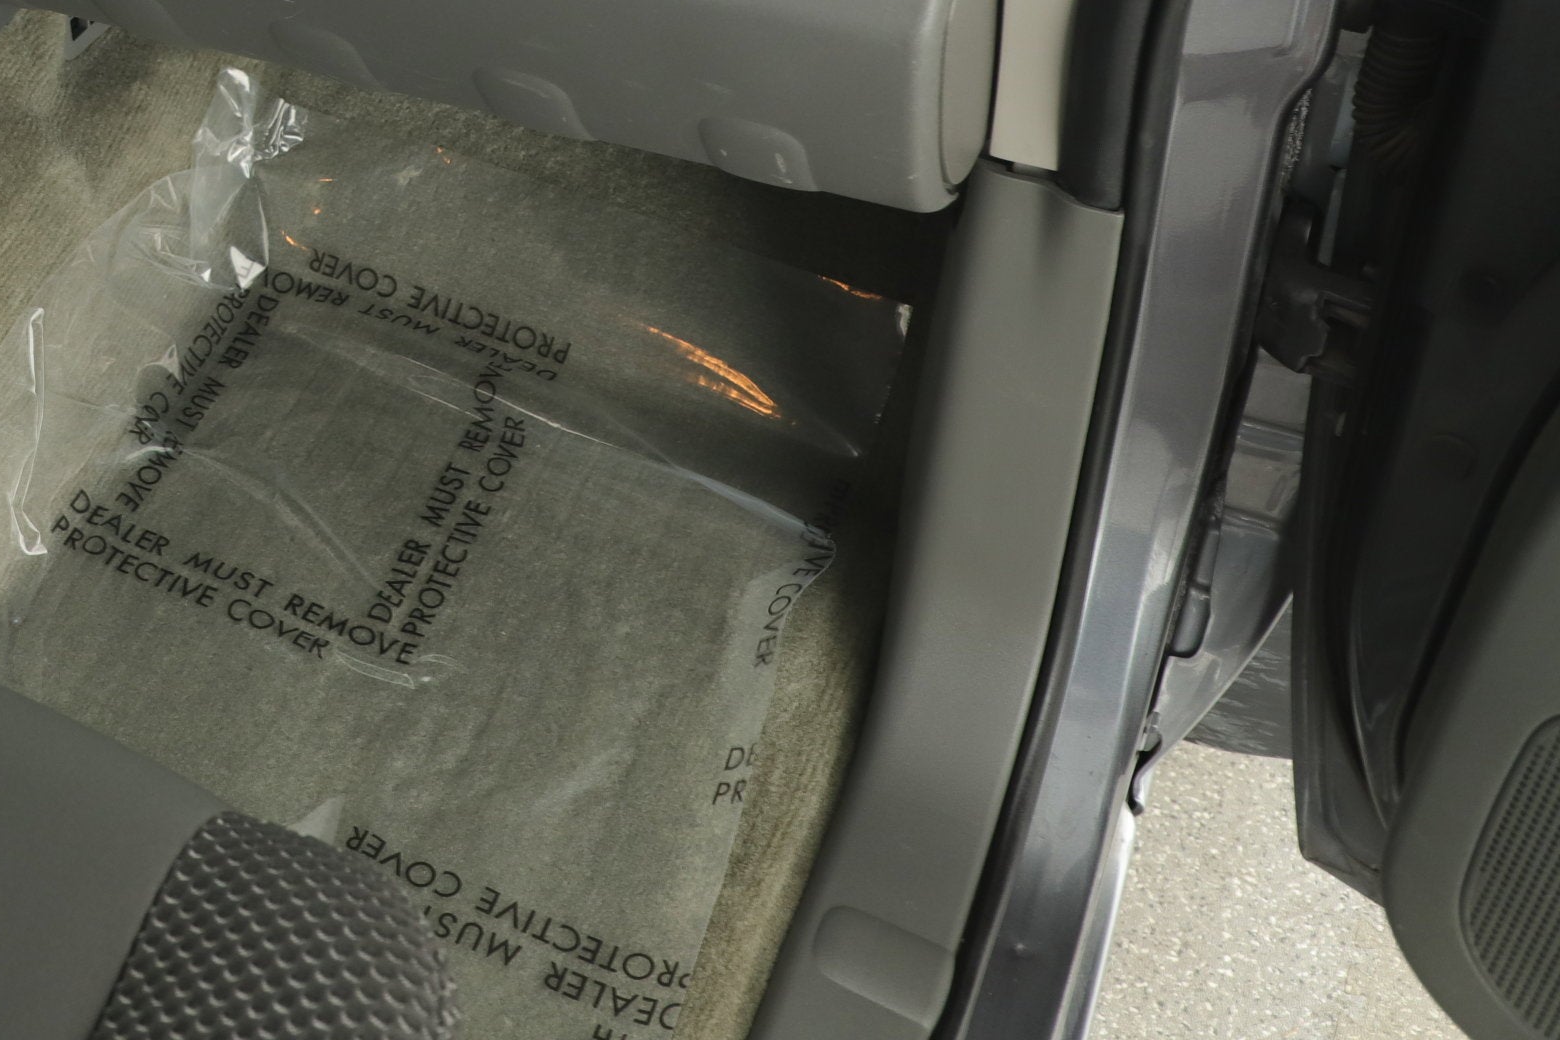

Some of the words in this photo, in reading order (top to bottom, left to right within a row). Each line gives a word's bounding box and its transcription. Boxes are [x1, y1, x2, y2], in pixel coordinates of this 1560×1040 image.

[309, 249, 397, 298] COVER
[218, 294, 279, 369] DEALER
[359, 304, 441, 335] MUST
[407, 286, 571, 364] PROTECTIVE
[454, 336, 558, 381] DEALER
[176, 376, 226, 432] MUST
[367, 538, 431, 623] DEALER
[419, 462, 471, 527] MUST
[401, 499, 491, 638] PROTECTIVE
[478, 416, 526, 492] COVER
[51, 515, 218, 608] PROTECTIVE
[227, 598, 330, 659] COVER
[69, 489, 170, 556] DEALER
[182, 552, 274, 598] MUST
[284, 593, 418, 665] REMOVE
[345, 825, 462, 898] COVER
[424, 905, 522, 966] MUS
[543, 961, 681, 1030] DEALER
